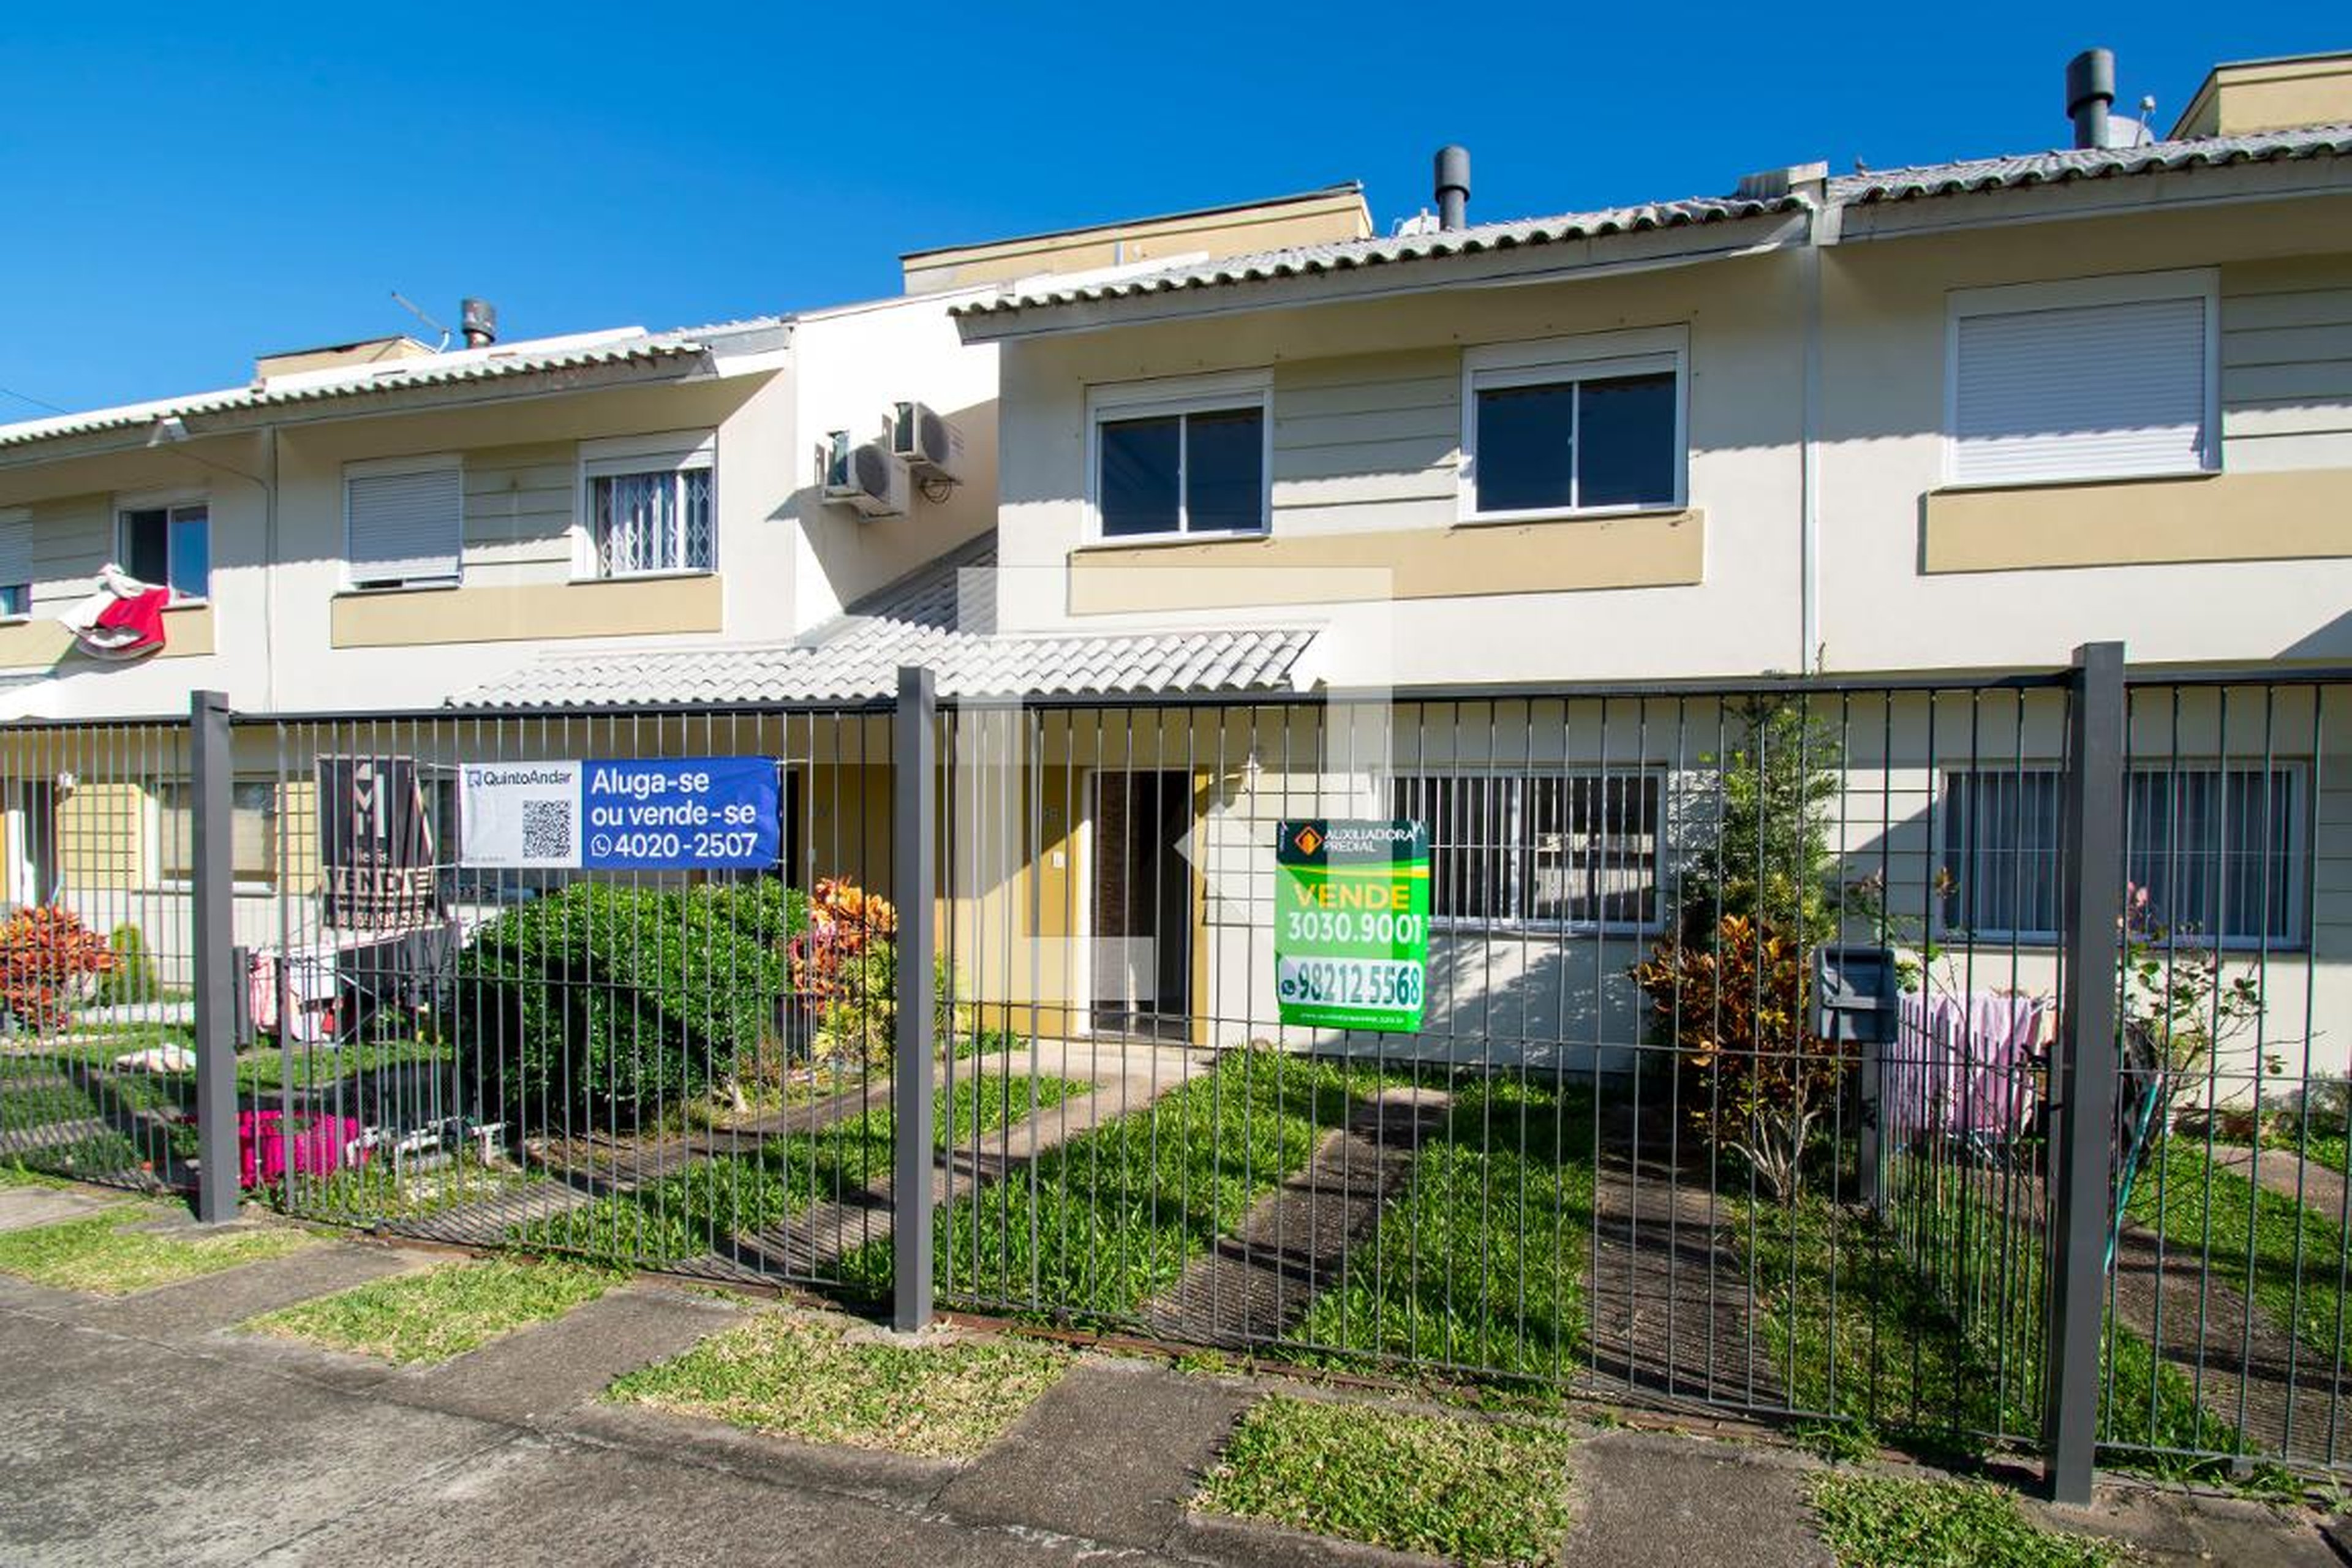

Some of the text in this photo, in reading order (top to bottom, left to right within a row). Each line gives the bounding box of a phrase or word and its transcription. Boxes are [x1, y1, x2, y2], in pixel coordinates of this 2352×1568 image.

[483, 770, 572, 786] QuintoAndar
[591, 768, 709, 799] Aluga-se
[591, 799, 756, 826] ou vende-se
[614, 832, 758, 858] 4020-2507
[1323, 841, 1378, 853] PREDIAL
[1324, 828, 1416, 842] AUXILIADORA
[1294, 883, 1409, 910] VENDE
[1289, 911, 1422, 944] 3030.9001
